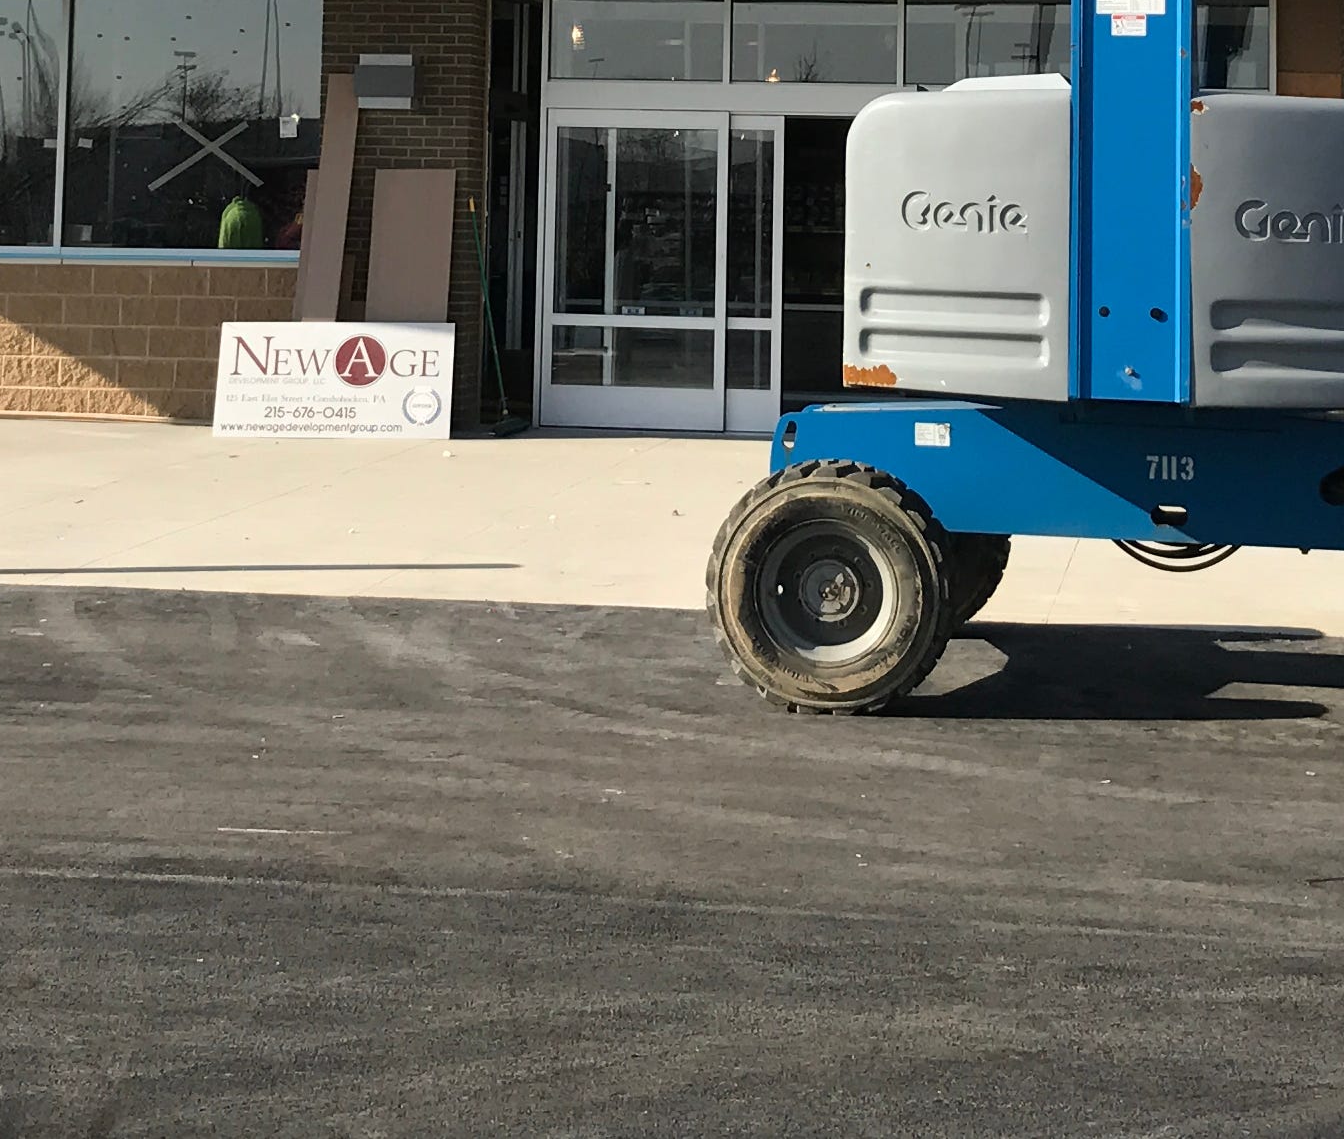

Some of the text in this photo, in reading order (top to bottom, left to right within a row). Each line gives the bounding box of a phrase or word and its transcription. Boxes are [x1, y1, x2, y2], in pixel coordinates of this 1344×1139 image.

[901, 190, 1029, 234] Genie
[228, 377, 280, 385] DEVELOPMENT
[264, 406, 356, 419] 215-676-0415
[220, 422, 403, 434] www.newagedevelopmentgroup.com
[1146, 455, 1194, 480] 7113
